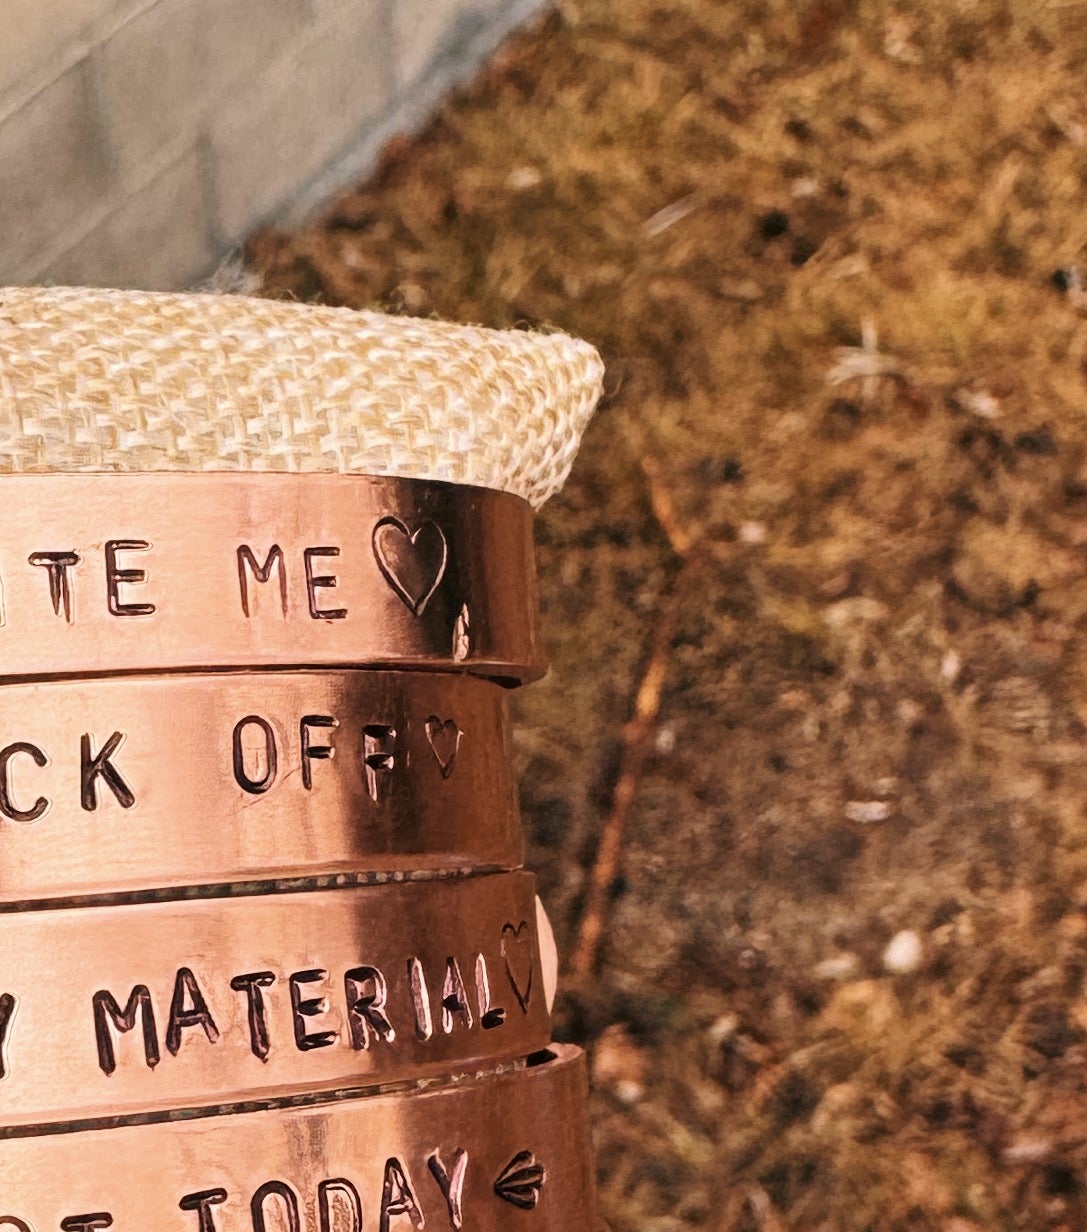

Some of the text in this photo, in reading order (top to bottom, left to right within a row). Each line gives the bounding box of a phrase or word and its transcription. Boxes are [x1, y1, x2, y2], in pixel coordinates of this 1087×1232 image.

[237, 543, 349, 620] ME
[232, 715, 397, 802] OFF
[93, 952, 506, 1077] MATERIAL
